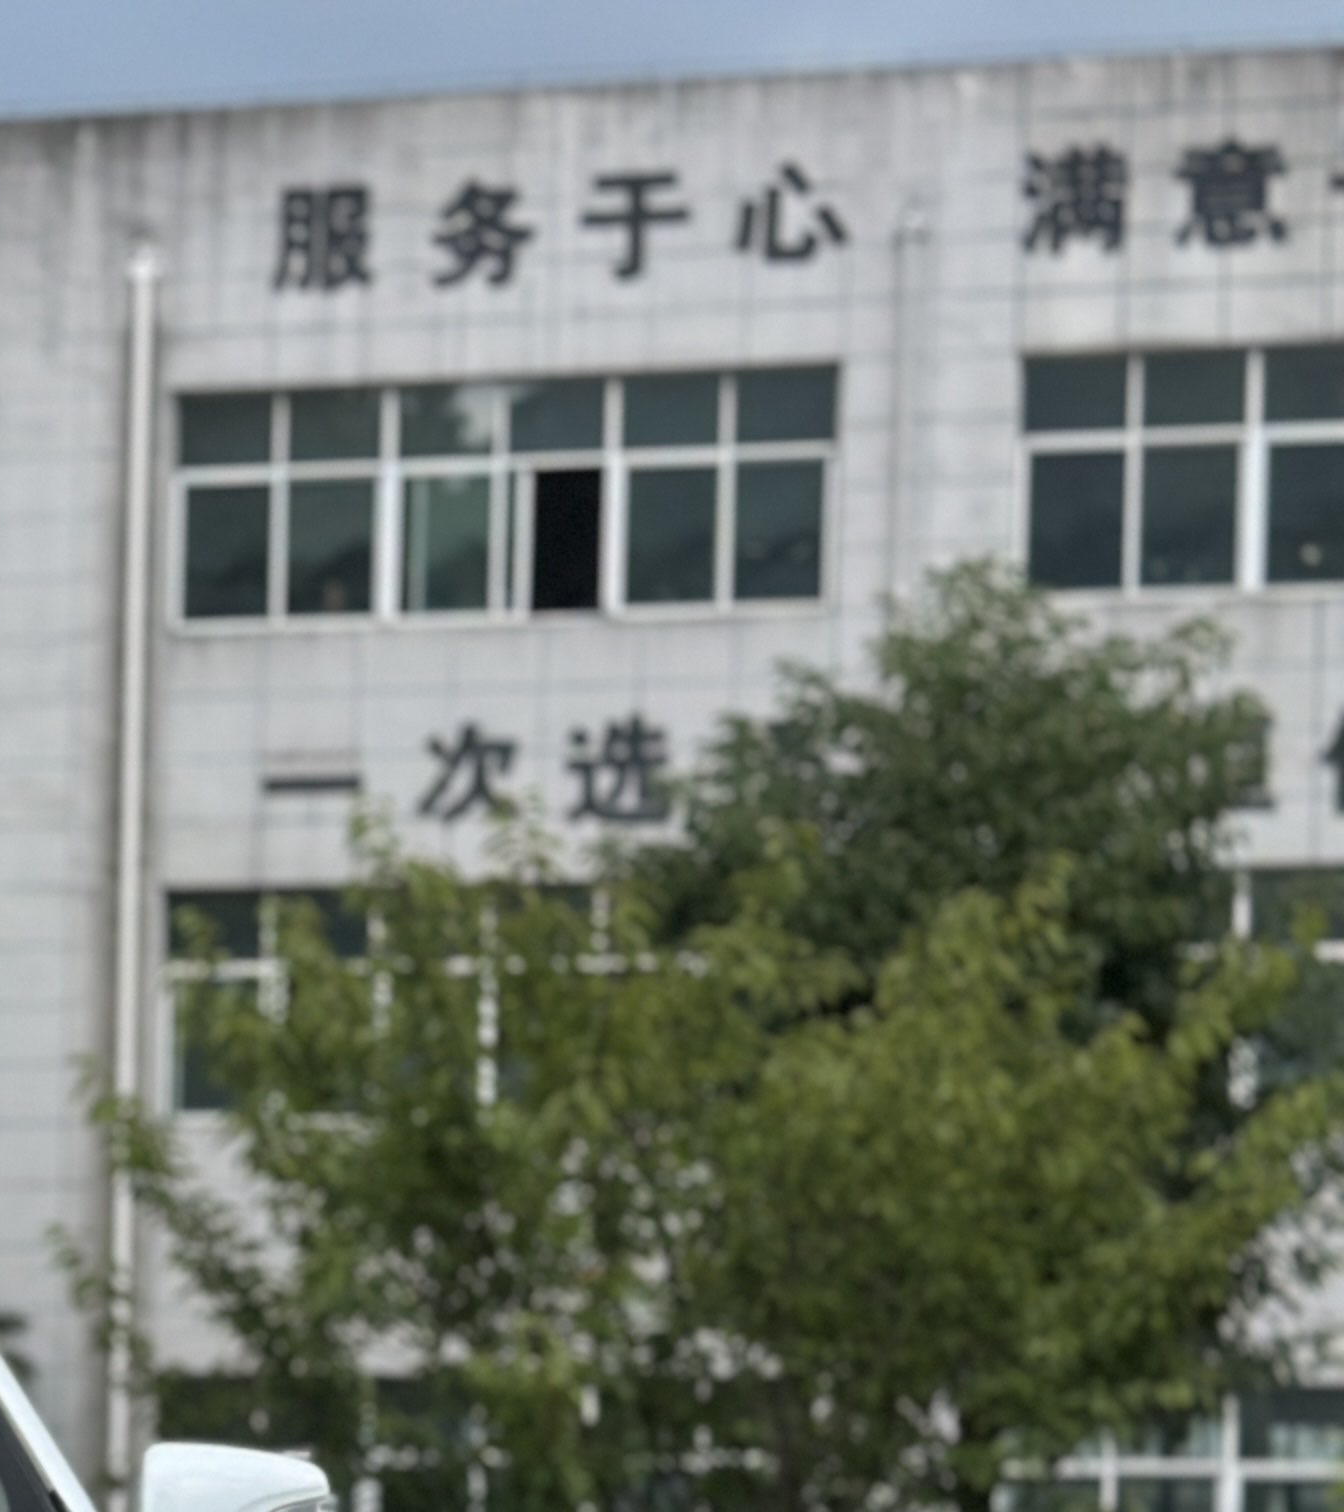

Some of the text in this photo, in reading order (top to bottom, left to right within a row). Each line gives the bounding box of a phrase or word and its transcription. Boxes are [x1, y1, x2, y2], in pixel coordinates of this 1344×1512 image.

[270, 136, 1344, 294] 服务于心 满意
[262, 711, 812, 824] 一次选
